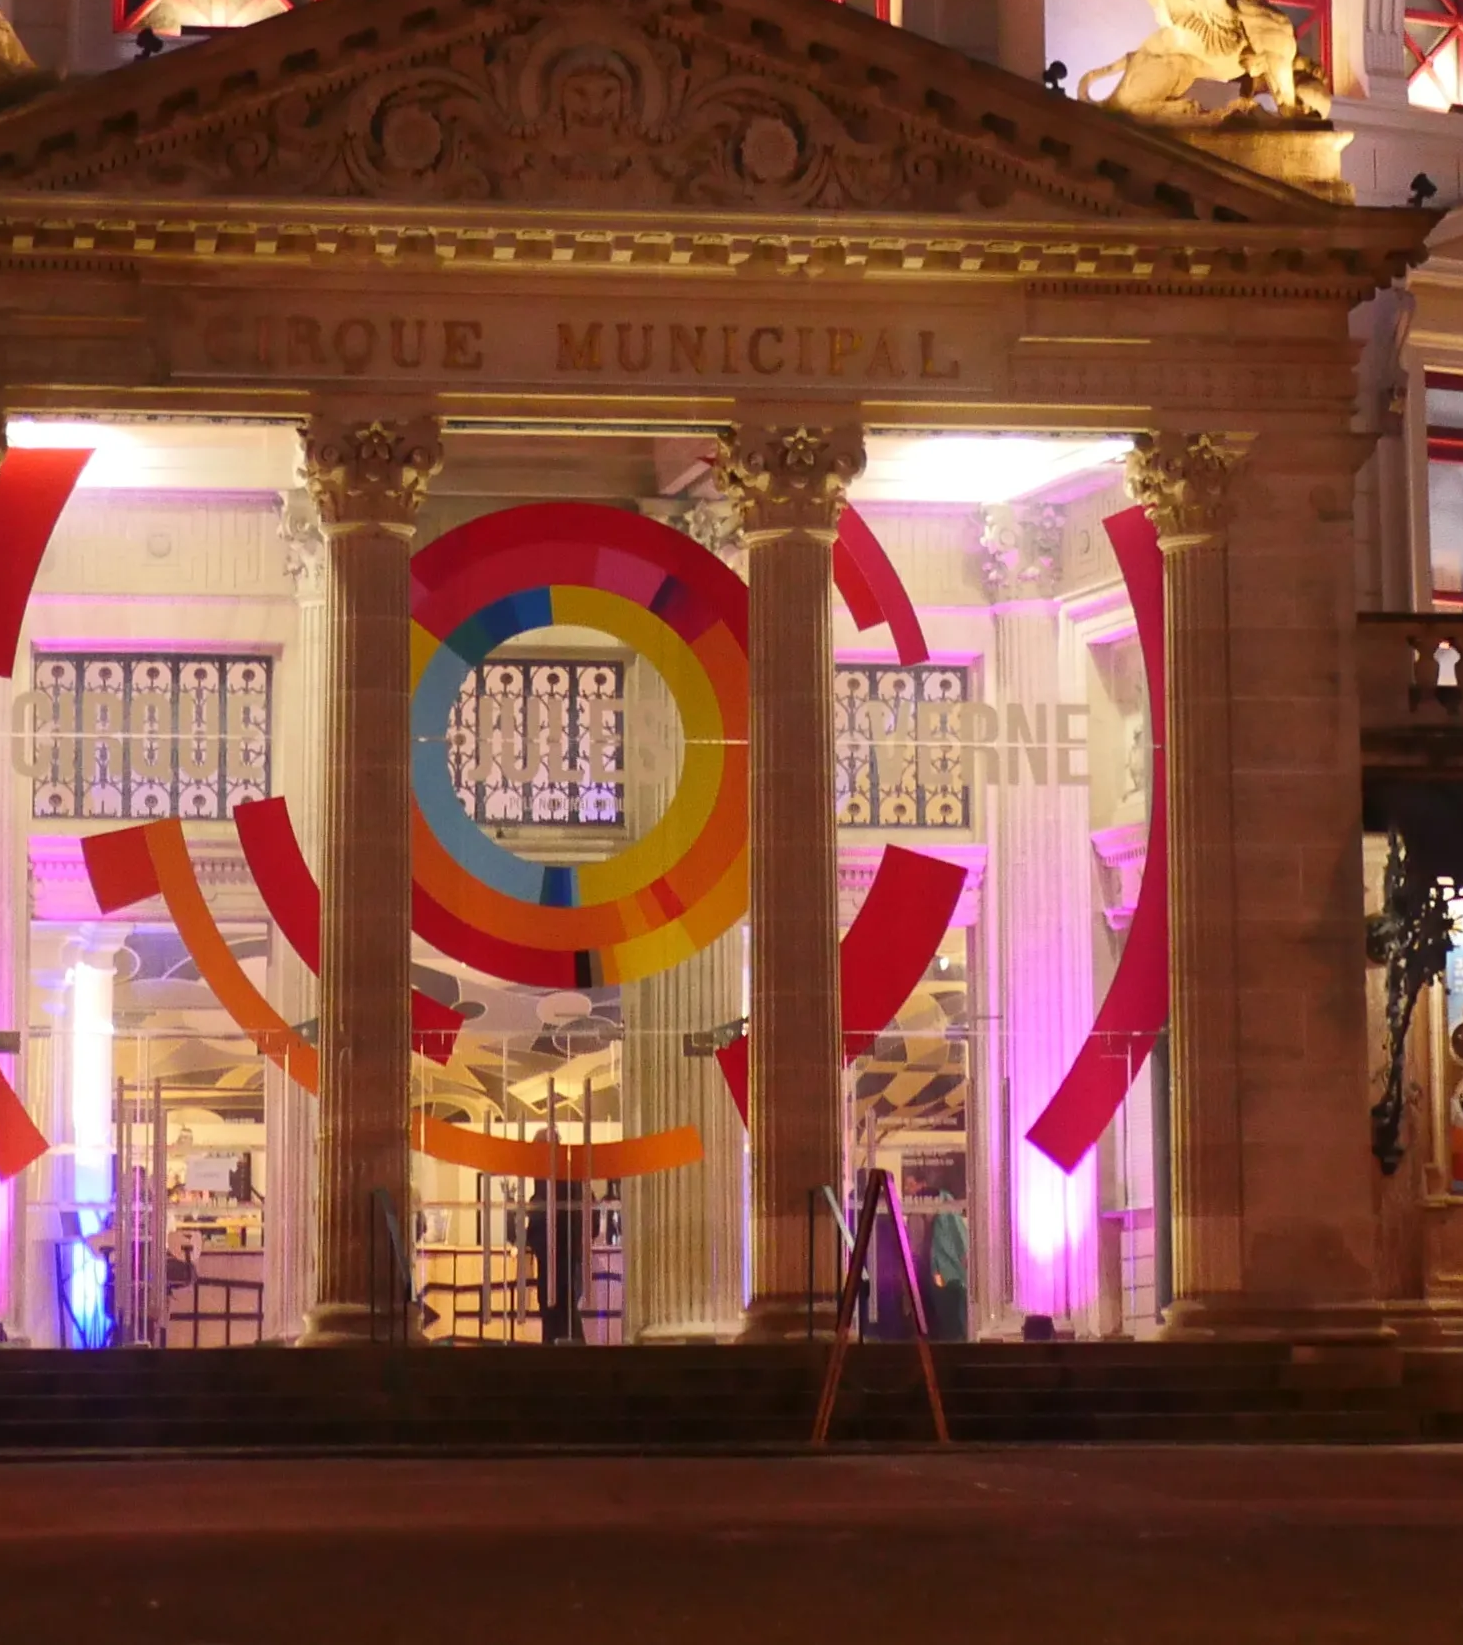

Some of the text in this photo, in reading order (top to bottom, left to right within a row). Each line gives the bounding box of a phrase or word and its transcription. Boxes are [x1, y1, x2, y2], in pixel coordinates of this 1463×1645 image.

[201, 316, 962, 381] CIRQUE MUNICIPAL
[11, 690, 1091, 786] CIRQUE JULES VERNE
